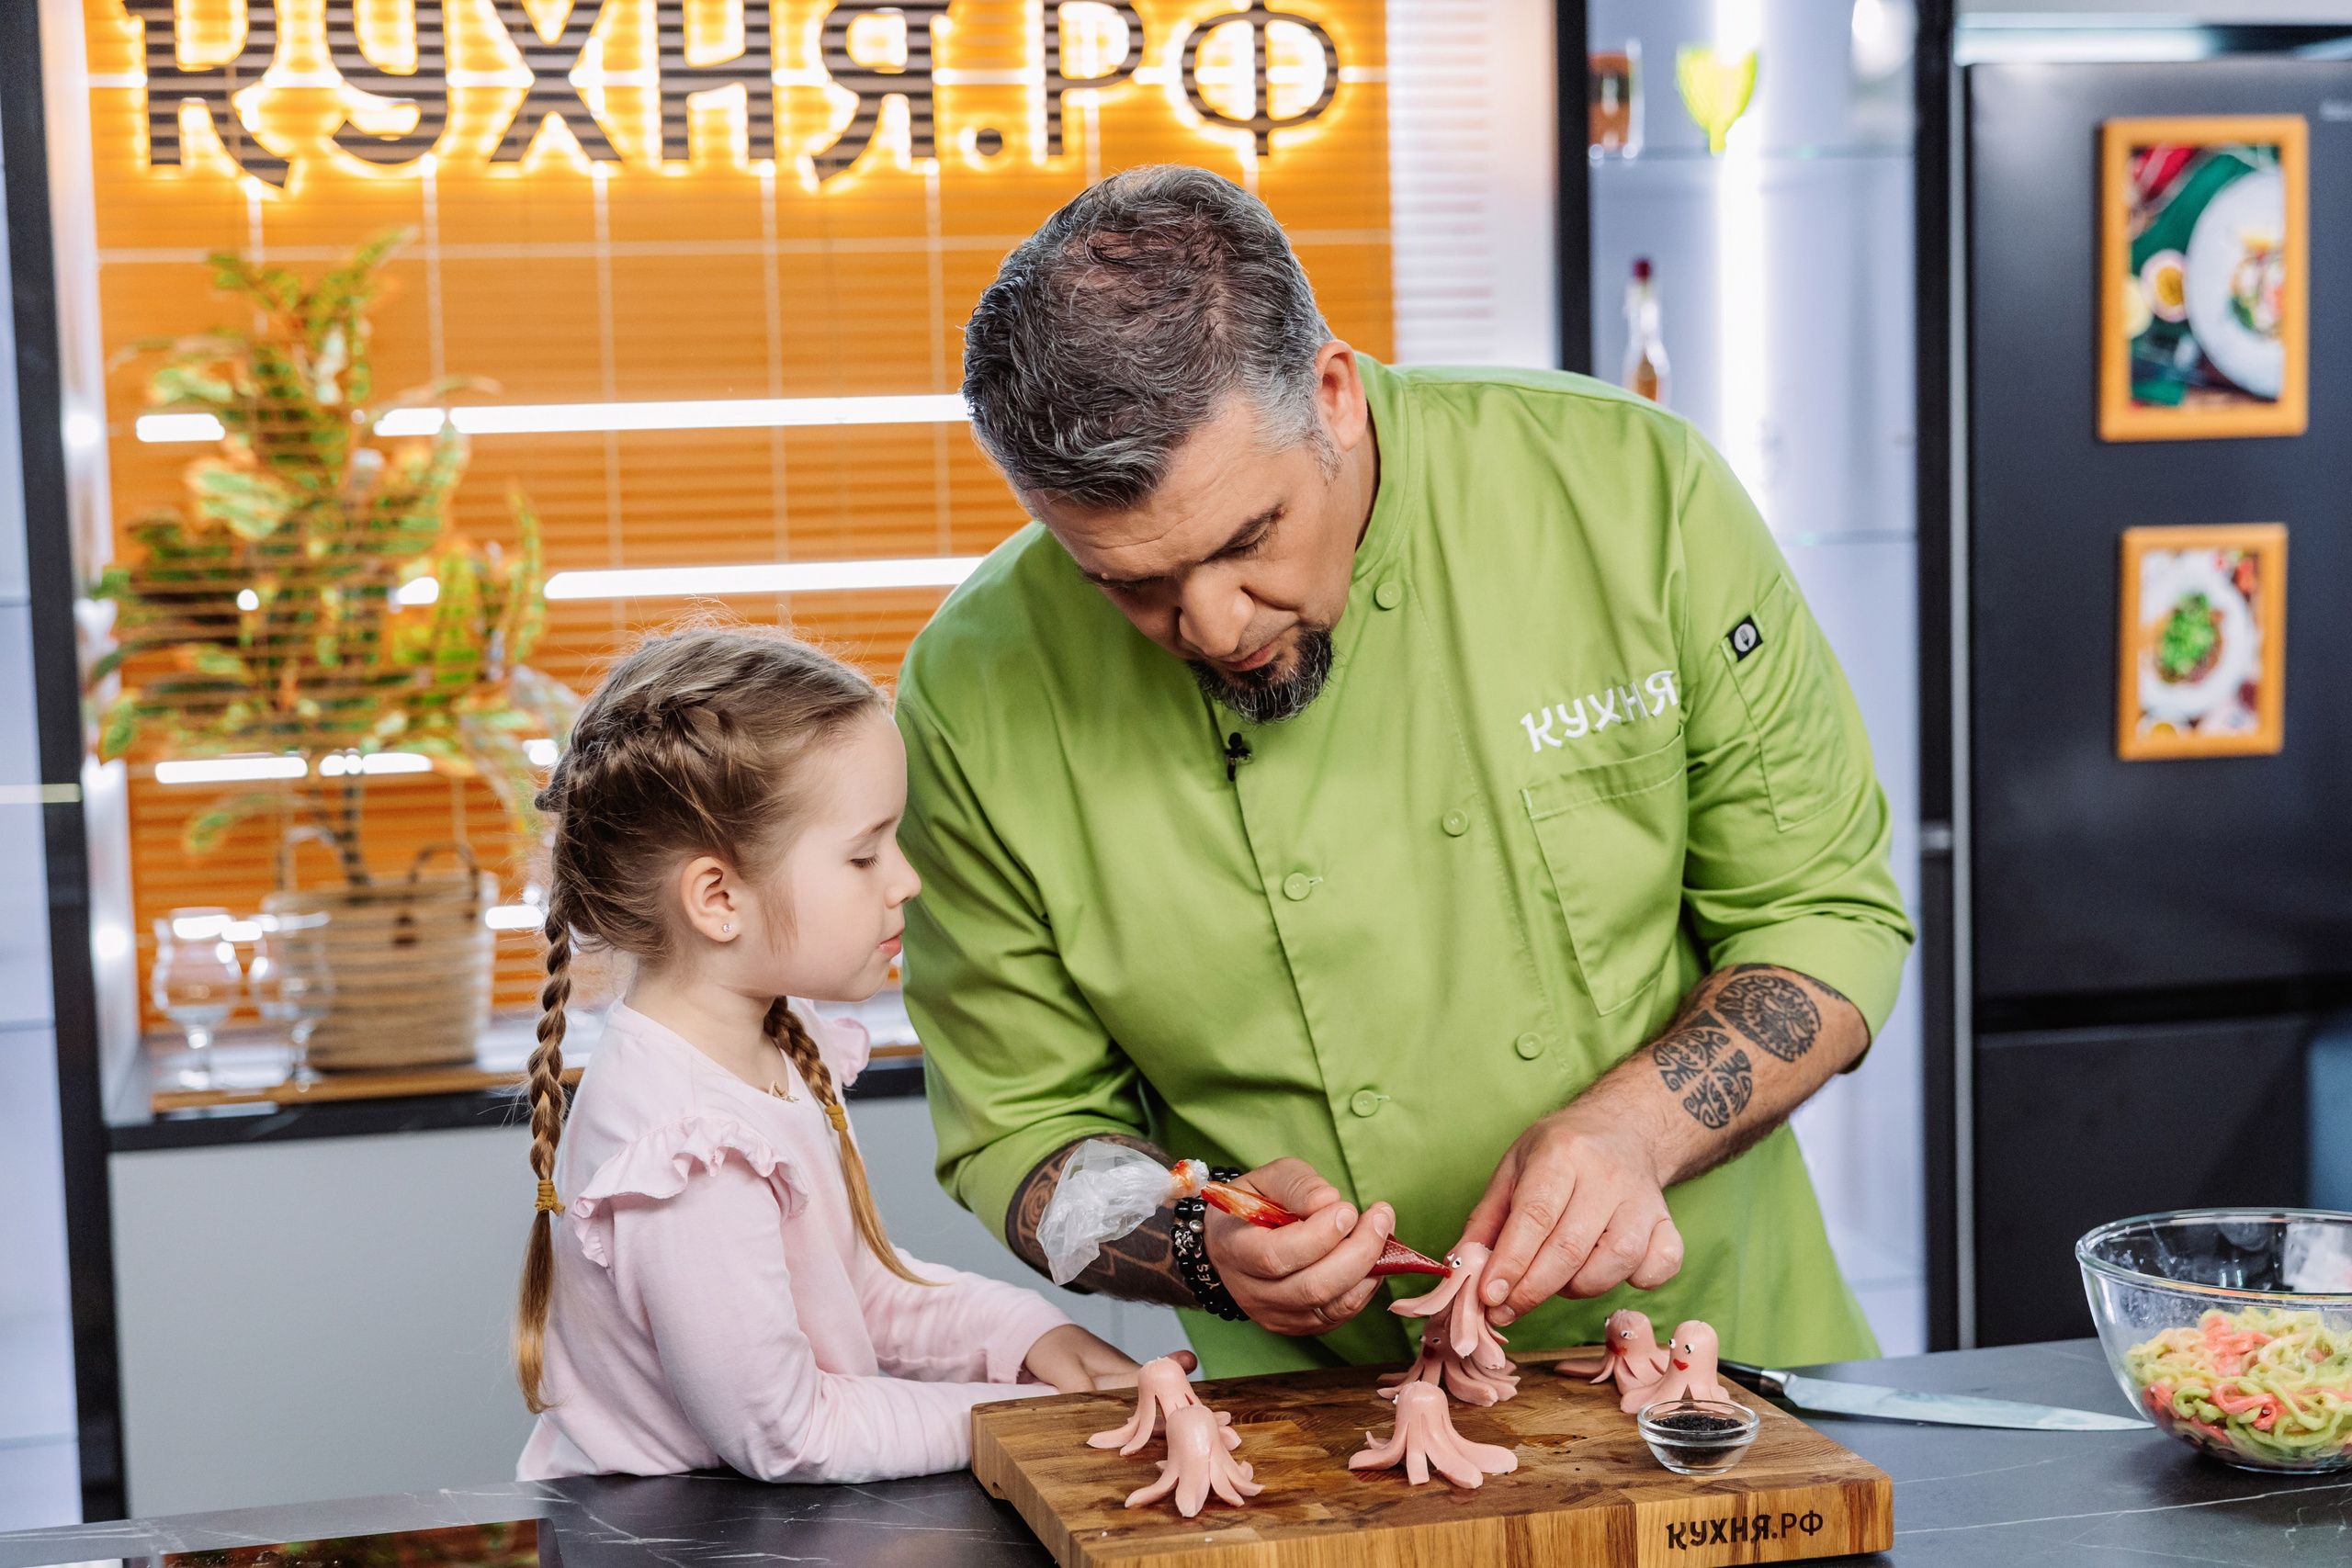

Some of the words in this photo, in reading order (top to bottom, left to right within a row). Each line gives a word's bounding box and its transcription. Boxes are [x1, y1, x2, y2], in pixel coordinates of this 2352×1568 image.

[121, 0, 1339, 189] КУХНЯ.РФ
[1520, 670, 1679, 752] КУХНЯ
[1196, 1263, 1222, 1290] YES
[1666, 1510, 1824, 1551] КУХНЯ.РФ
